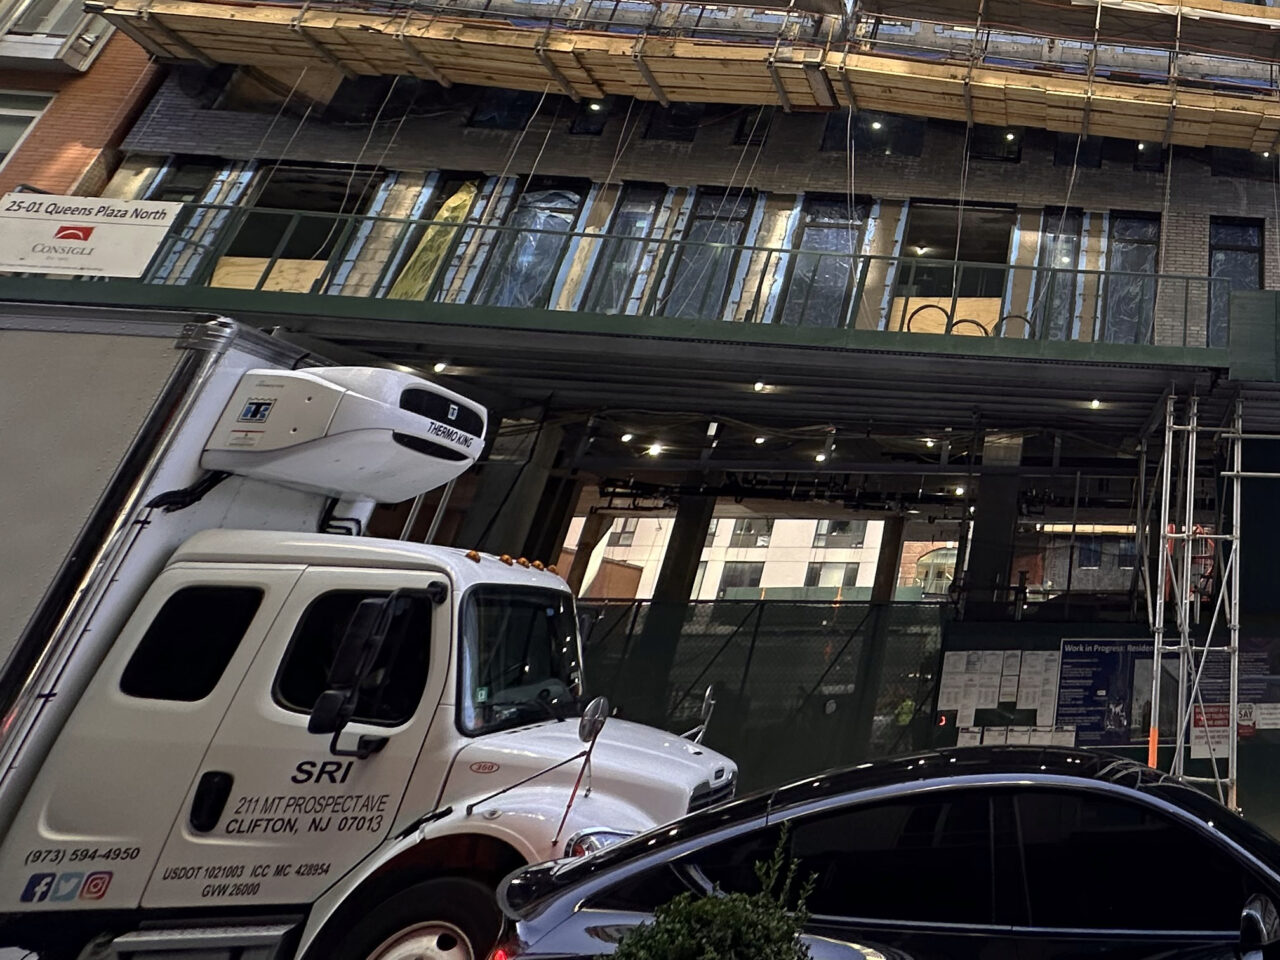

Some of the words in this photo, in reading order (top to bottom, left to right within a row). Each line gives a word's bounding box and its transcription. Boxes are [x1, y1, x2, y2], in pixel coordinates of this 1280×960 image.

[4, 200, 43, 213] 25-01
[45, 202, 94, 216] Queens
[95, 205, 129, 219] Plaza
[129, 208, 167, 221] North
[427, 421, 459, 442] THERMO
[456, 433, 474, 448] KING
[1064, 644, 1084, 652] Work
[1085, 644, 1092, 652] in
[290, 760, 354, 784] SRI
[234, 797, 261, 815] 211
[259, 796, 285, 815] MT
[225, 818, 299, 835] CLIFTON,
[308, 816, 332, 832] NJ
[338, 815, 385, 832] 07013
[24, 849, 66, 866] (973)
[69, 847, 141, 861] 594-4950
[162, 866, 202, 880] USDOT
[203, 865, 245, 879] 1021003
[250, 864, 271, 878] ICC
[273, 864, 293, 877] MC
[294, 863, 332, 876] 428954
[202, 883, 231, 897] GVW
[228, 882, 261, 896] 26000
